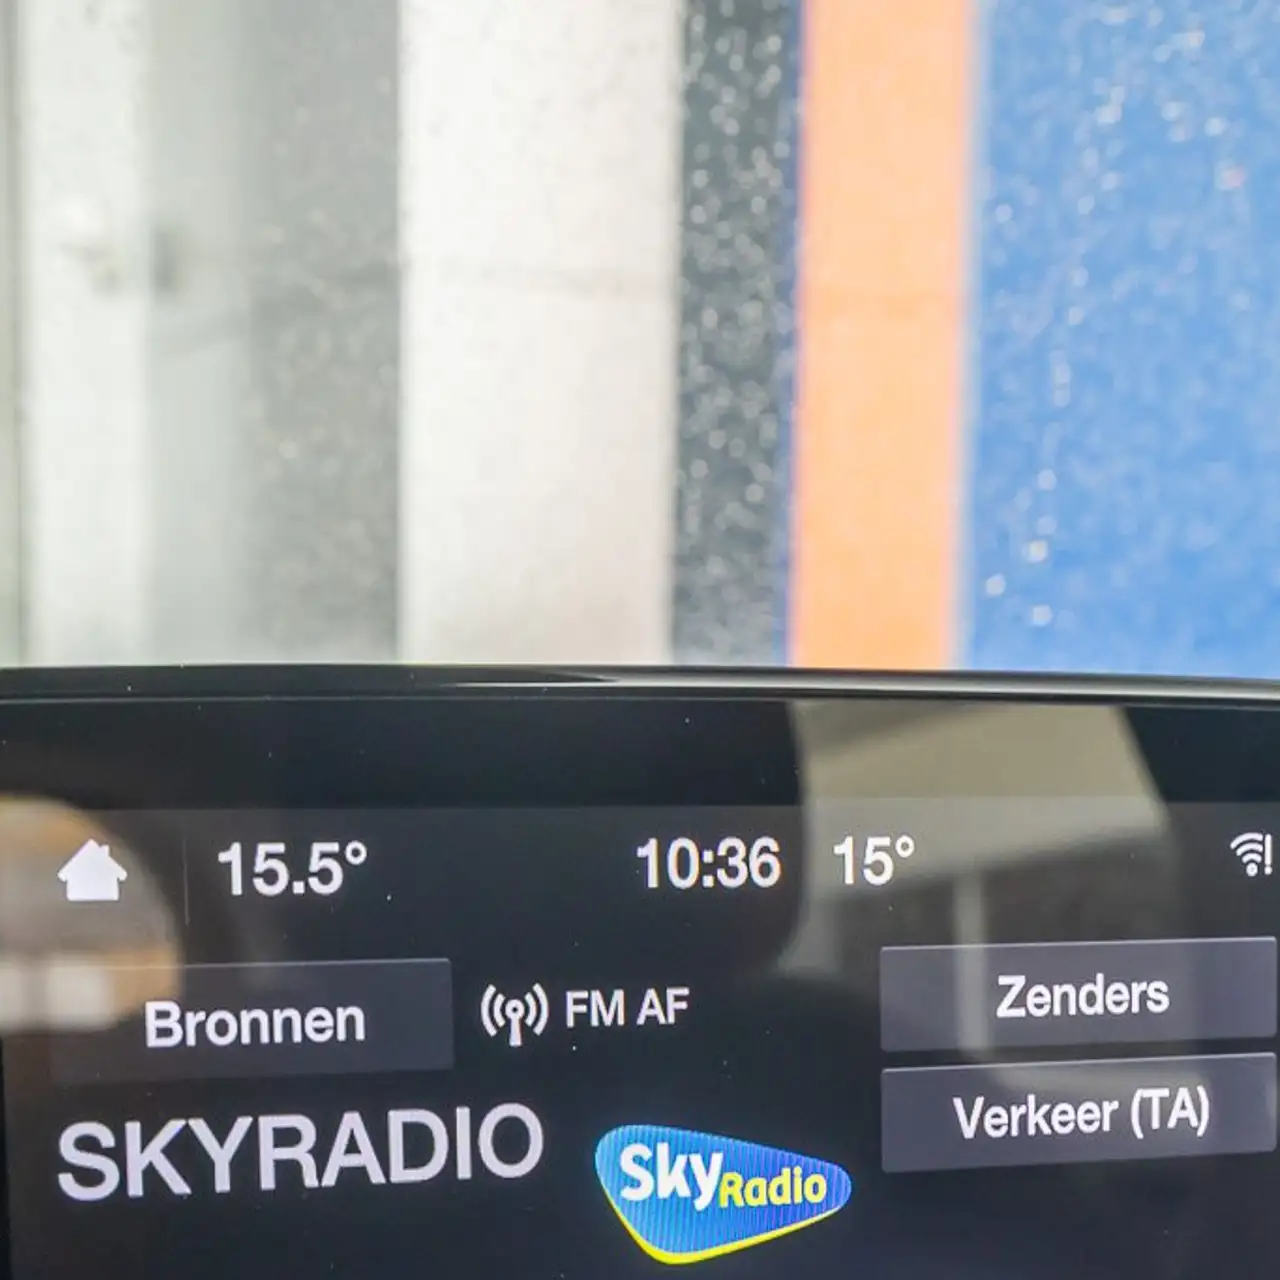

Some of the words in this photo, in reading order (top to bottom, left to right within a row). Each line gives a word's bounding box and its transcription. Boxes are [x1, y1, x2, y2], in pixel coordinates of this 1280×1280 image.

[637, 837, 781, 889] 10:36
[566, 990, 625, 1028] FM
[637, 987, 690, 1026] AF
[996, 973, 1170, 1018] Zenders
[145, 1000, 365, 1049] Bronnen
[952, 1090, 1119, 1139] Verkeer
[1131, 1084, 1210, 1138] (TA)
[58, 1102, 543, 1200] SKYRADIO
[619, 1143, 724, 1211] Sky
[719, 1166, 828, 1209] Radio
